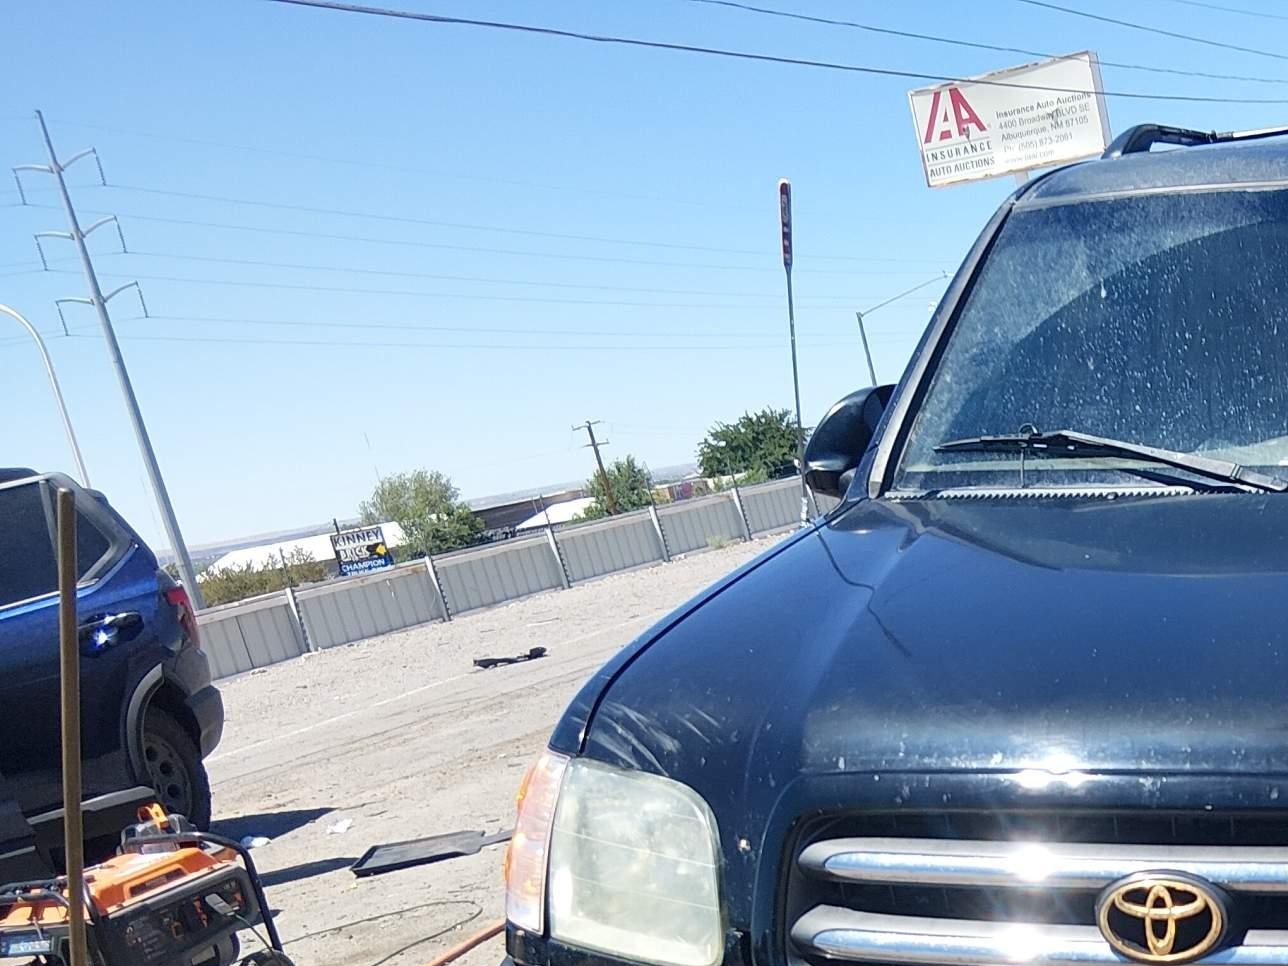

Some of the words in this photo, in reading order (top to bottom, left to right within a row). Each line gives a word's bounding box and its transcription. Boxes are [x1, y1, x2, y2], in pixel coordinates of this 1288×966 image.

[996, 102, 1035, 119] Insurance
[1036, 98, 1054, 109] Auto
[1056, 91, 1091, 105] Auctions
[999, 119, 1017, 130] 4400
[1019, 110, 1056, 127] Broadway
[1055, 106, 1077, 118] BLVD
[1079, 103, 1090, 113] SE
[1051, 120, 1064, 132] NM
[1065, 116, 1089, 128] 87105
[926, 141, 993, 162] INSURANCE
[930, 165, 952, 178] AUTO
[954, 156, 995, 174] AUCTIONS
[334, 530, 379, 547] KINNEY
[342, 558, 385, 572] CHAMPION
